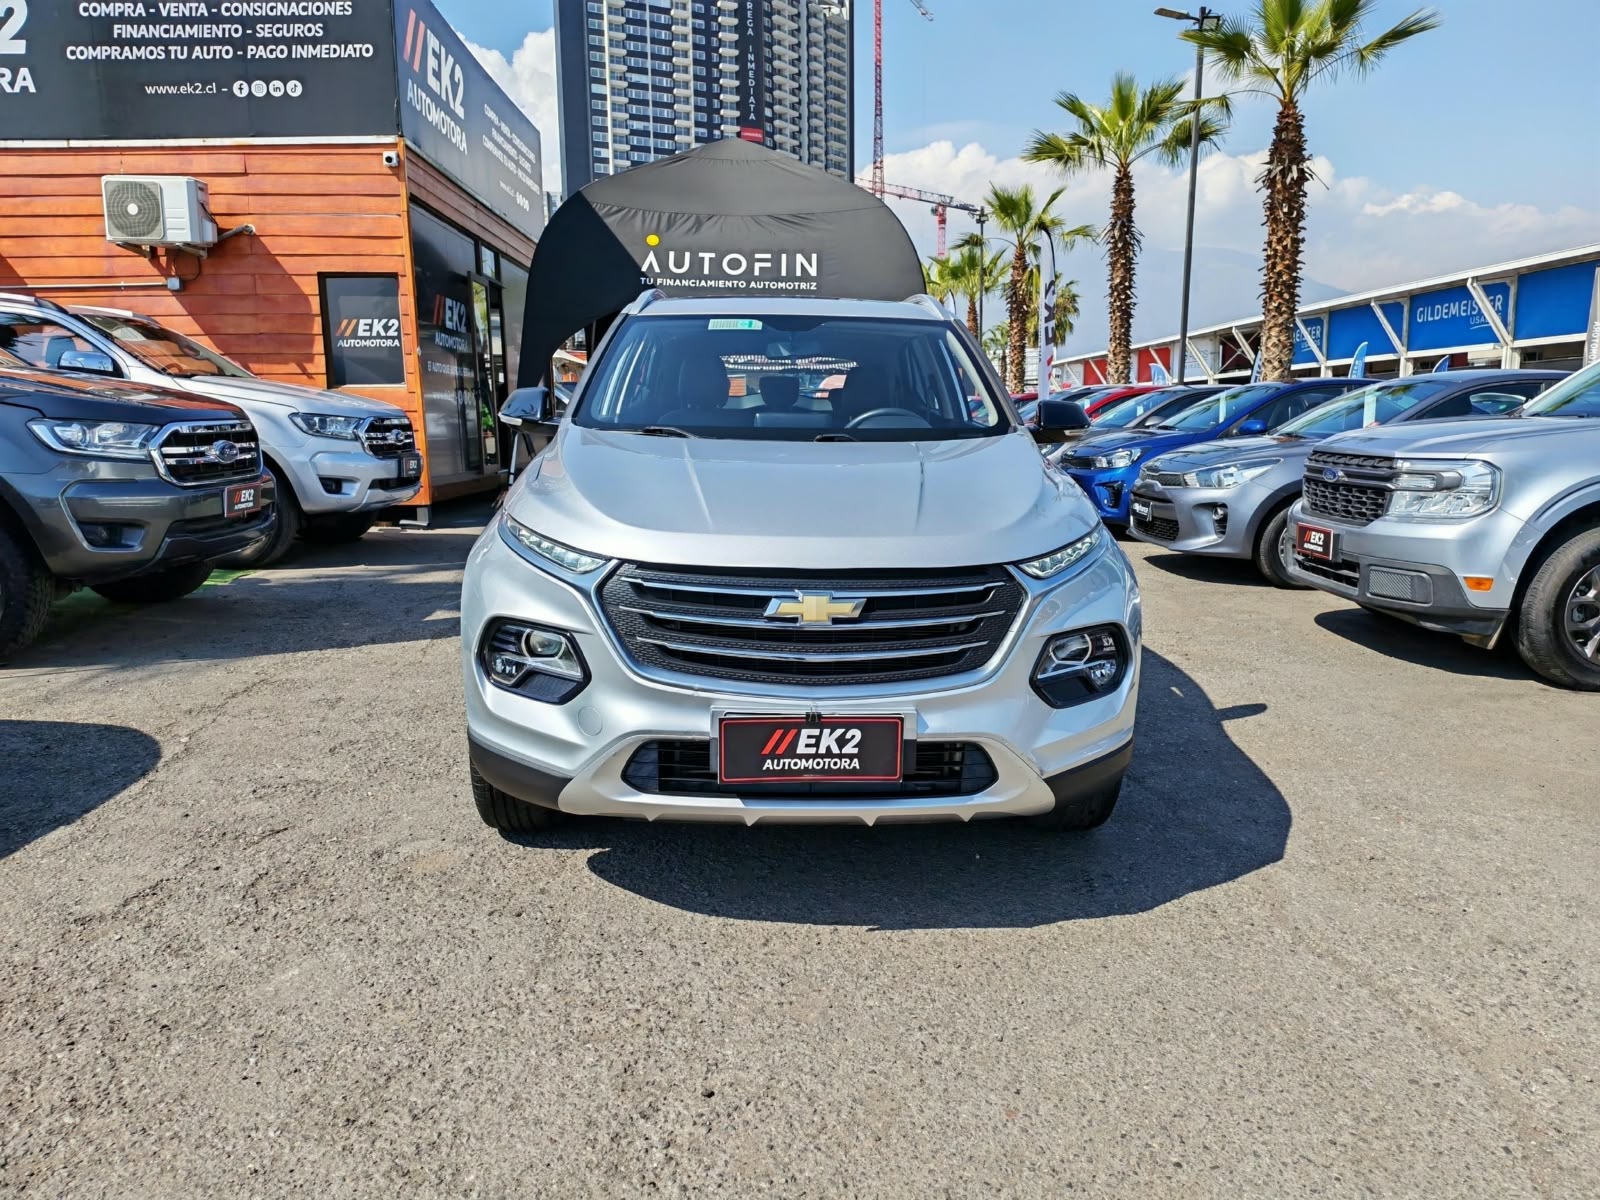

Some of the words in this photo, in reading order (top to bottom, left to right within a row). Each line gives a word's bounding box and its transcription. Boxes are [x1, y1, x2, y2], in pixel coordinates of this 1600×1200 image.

[78, 2, 147, 17] COMPRA
[159, 2, 208, 17] VENTA
[221, 1, 353, 17] CONSIGNACIONES
[746, 0, 754, 36] REGA
[113, 24, 243, 39] FINANCIAMIENTO
[255, 23, 324, 38] SEGUROS
[66, 45, 166, 60] COMPRAMOS
[168, 45, 188, 60] TU
[191, 45, 234, 60] AUTO
[247, 44, 289, 60] PAGO
[291, 43, 374, 59] INMEDIATO
[145, 82, 217, 95] www.ek2.cl
[747, 44, 756, 121] INMEDIATA
[406, 78, 468, 156] AUTOMOTORA
[640, 250, 817, 277] AUTOFIN
[640, 277, 654, 285] TU
[656, 278, 747, 288] FINANCIAMIENTO
[749, 281, 817, 290] AUTOMOTRIZ
[337, 339, 400, 348] AUTOMOTORA
[762, 758, 860, 771] AUTOMOTORA
